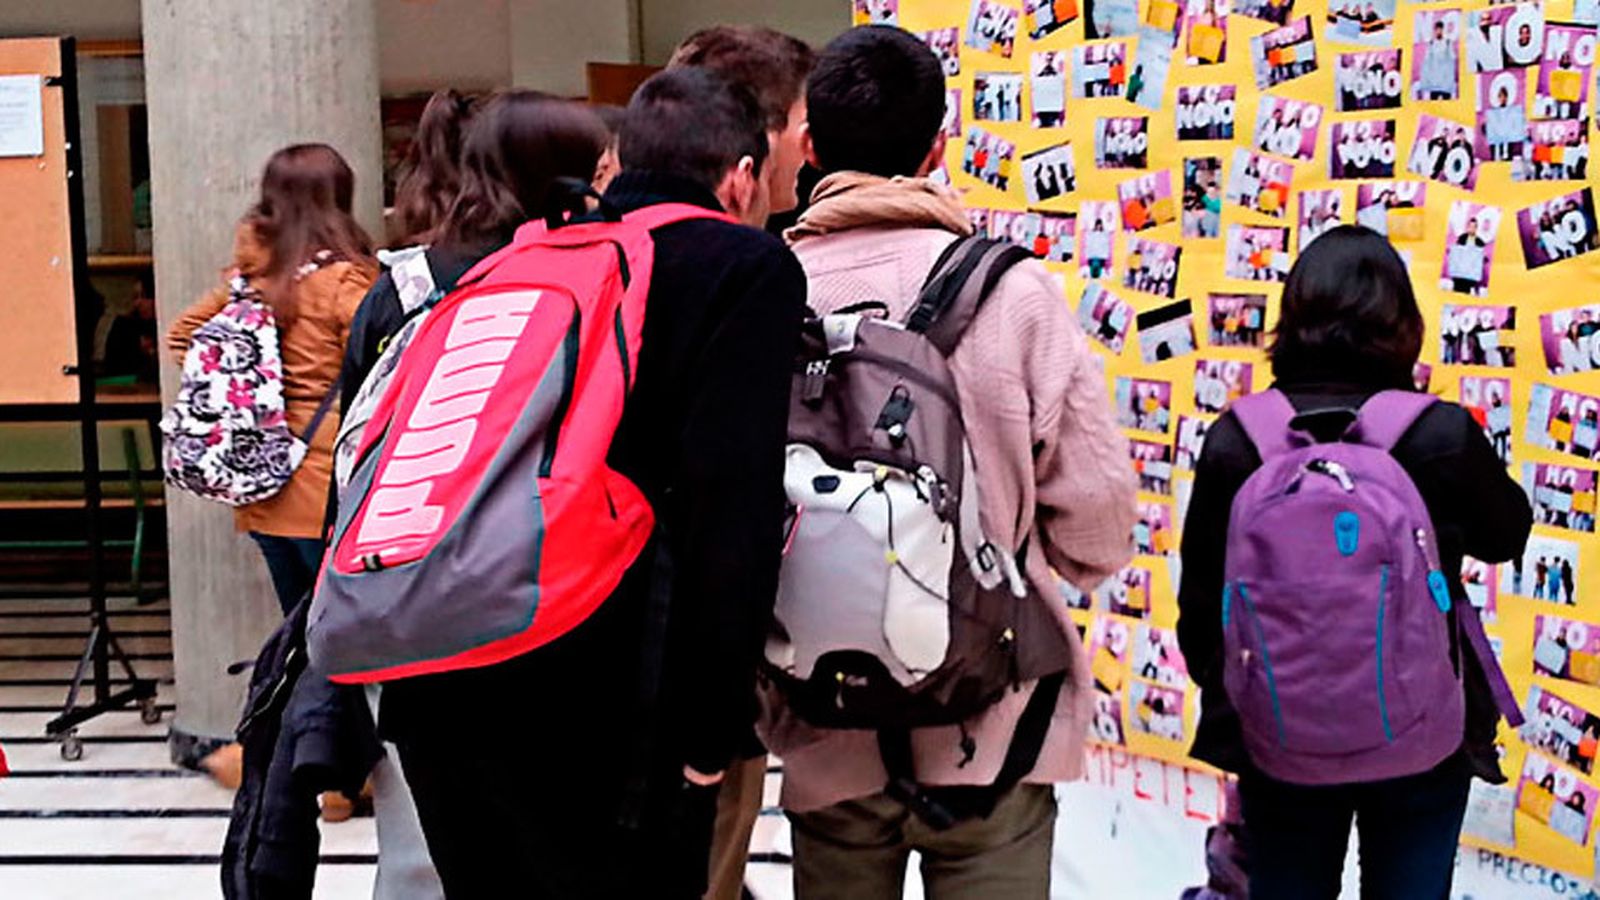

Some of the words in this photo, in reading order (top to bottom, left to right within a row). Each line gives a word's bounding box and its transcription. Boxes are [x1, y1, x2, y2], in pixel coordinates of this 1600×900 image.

[1467, 3, 1544, 72] NO
[1547, 30, 1595, 66] NO
[1410, 137, 1471, 185] NO
[1540, 210, 1587, 261] NO
[356, 290, 543, 543] PUMA
